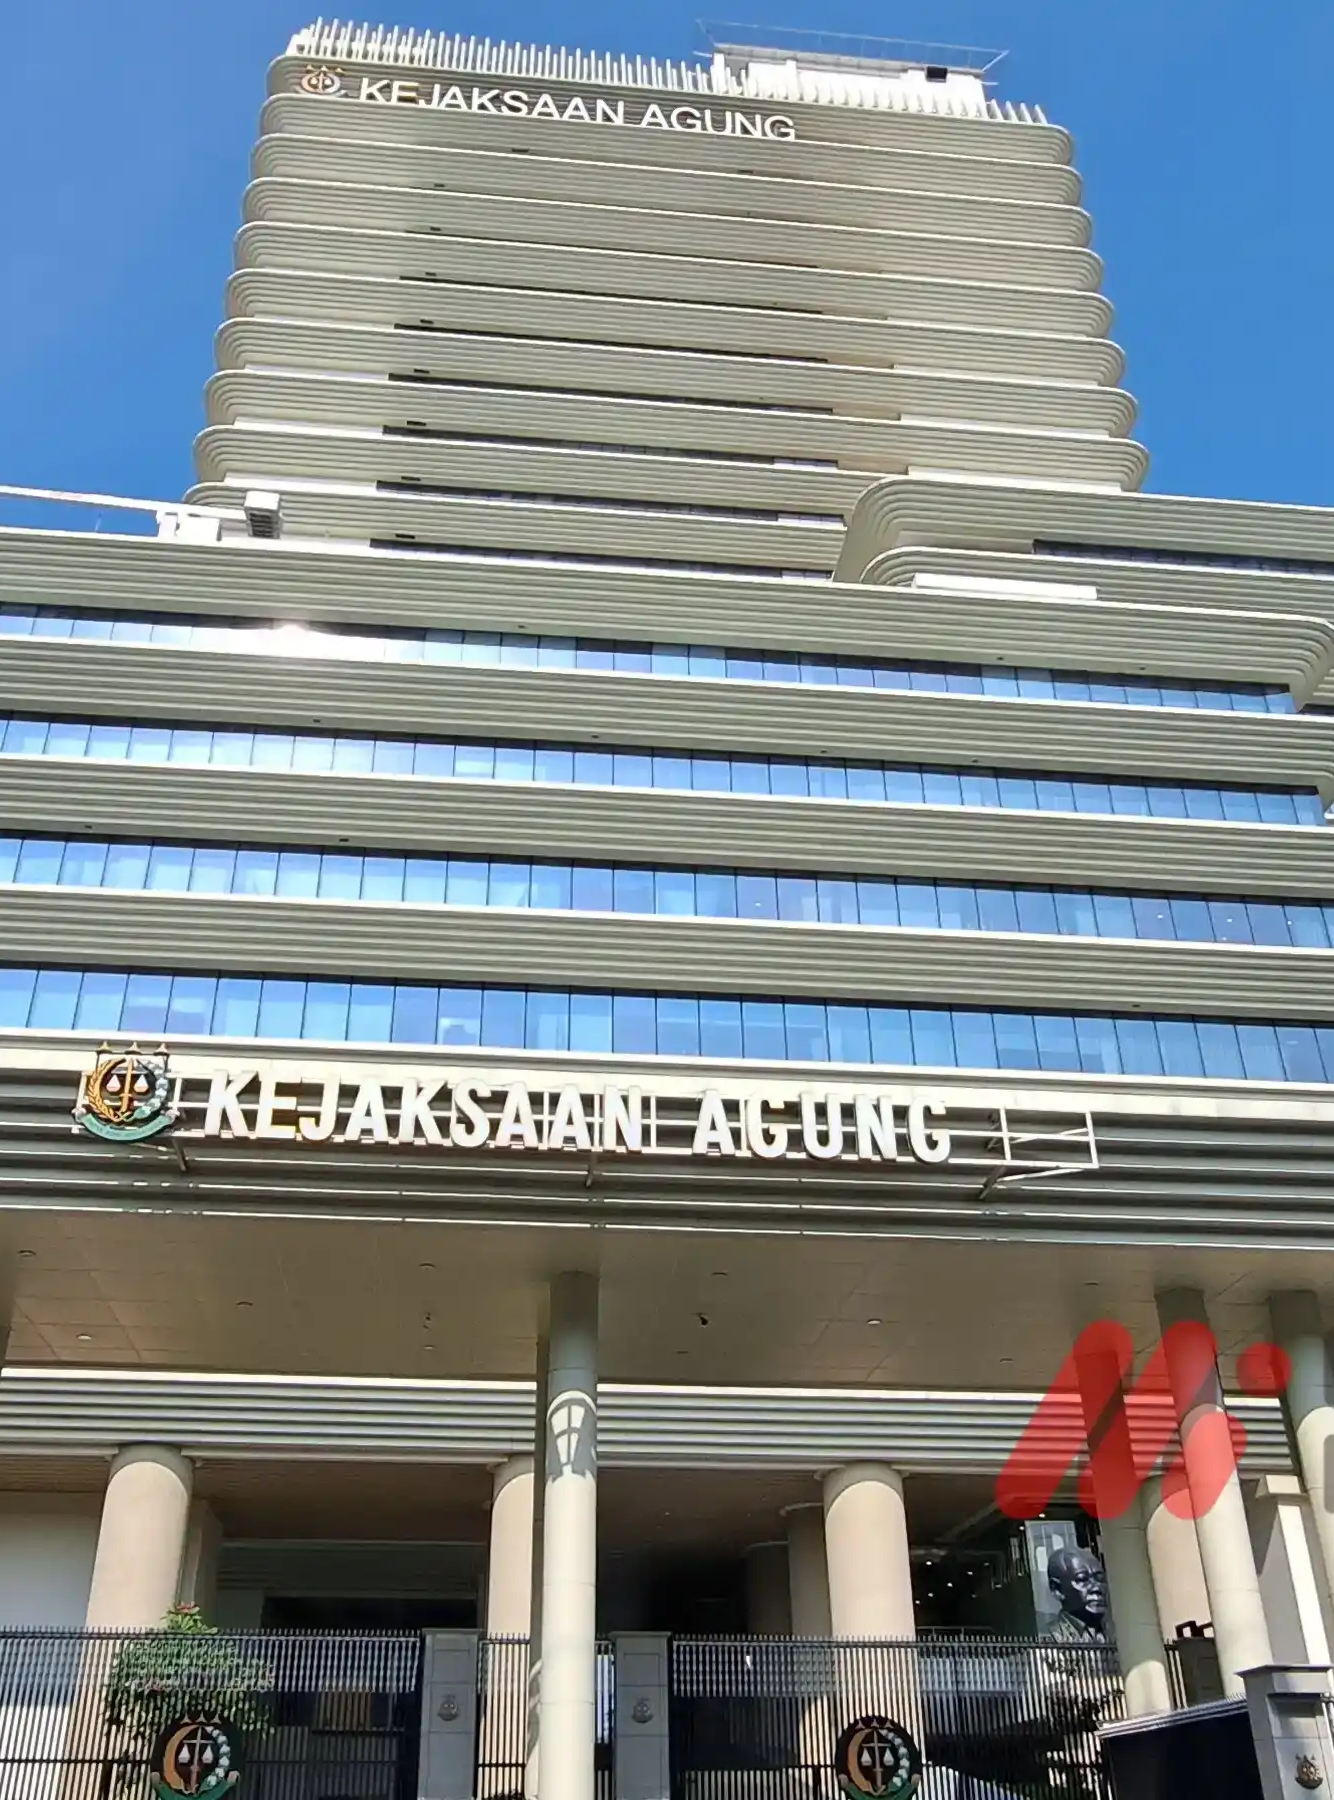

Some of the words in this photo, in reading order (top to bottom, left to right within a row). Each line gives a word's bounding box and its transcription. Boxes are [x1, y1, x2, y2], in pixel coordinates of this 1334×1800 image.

[359, 77, 625, 125] KEJAKSAAN
[640, 103, 796, 141] AGUNG
[204, 1068, 643, 1153] KEJAKSAAN
[692, 1088, 951, 1163] AGUNG
